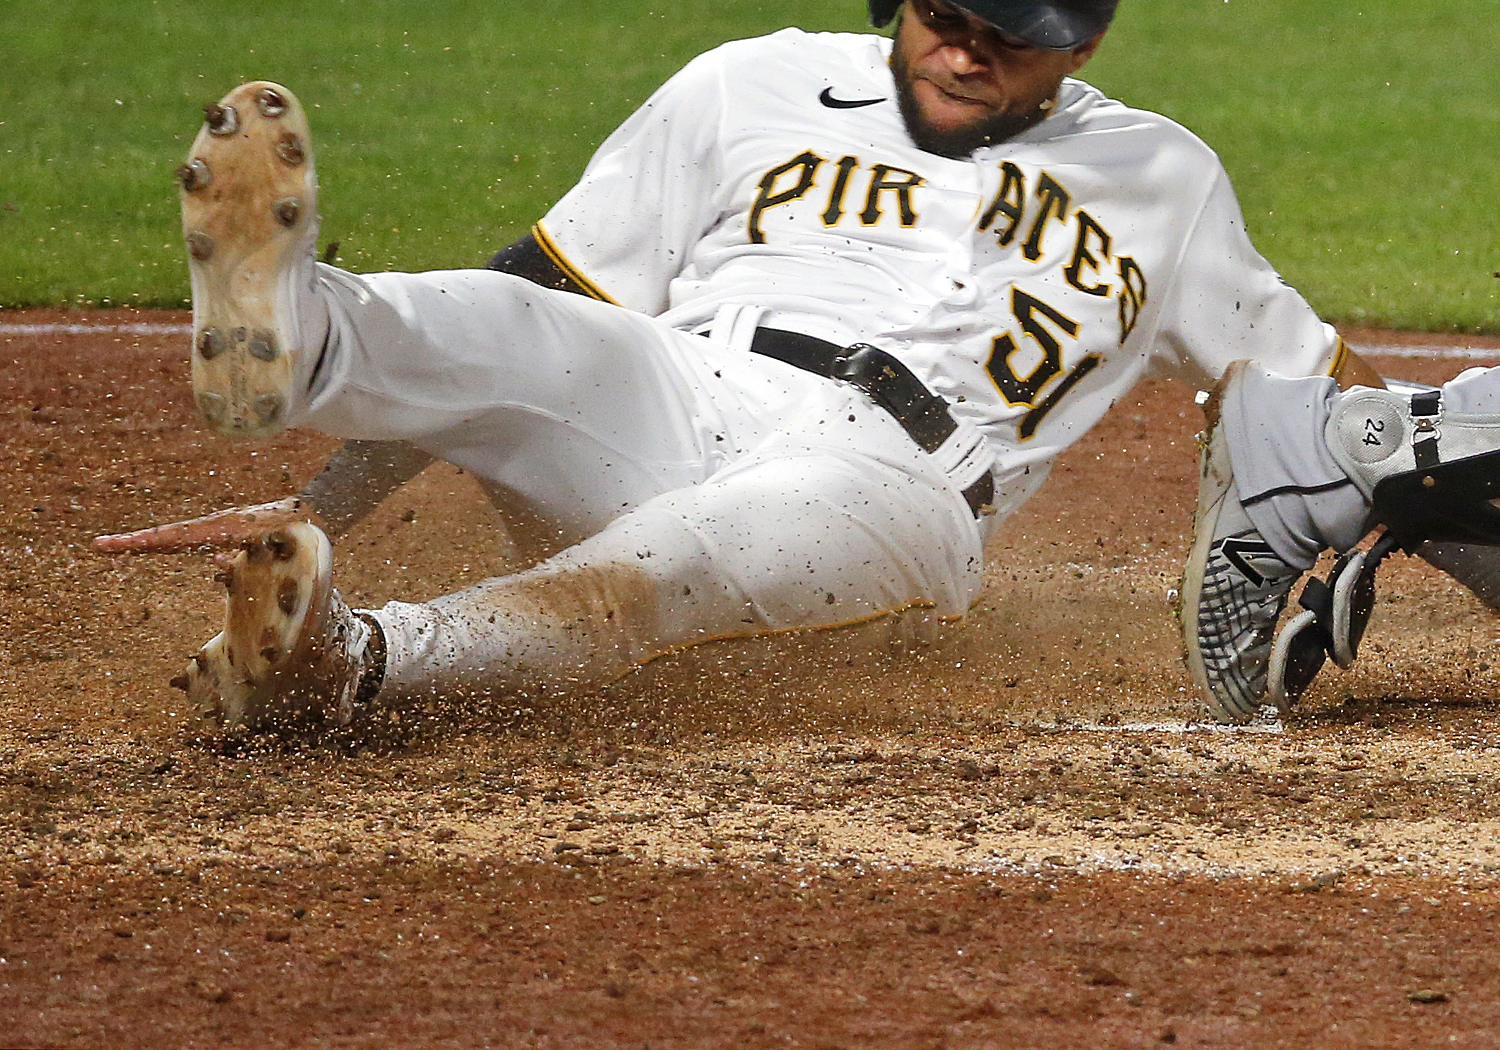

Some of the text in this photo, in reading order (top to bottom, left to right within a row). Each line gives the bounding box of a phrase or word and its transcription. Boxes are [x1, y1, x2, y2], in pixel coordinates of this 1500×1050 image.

[748, 149, 1147, 348] PIRATES
[984, 284, 1104, 443] 51
[1361, 417, 1385, 446] 24
